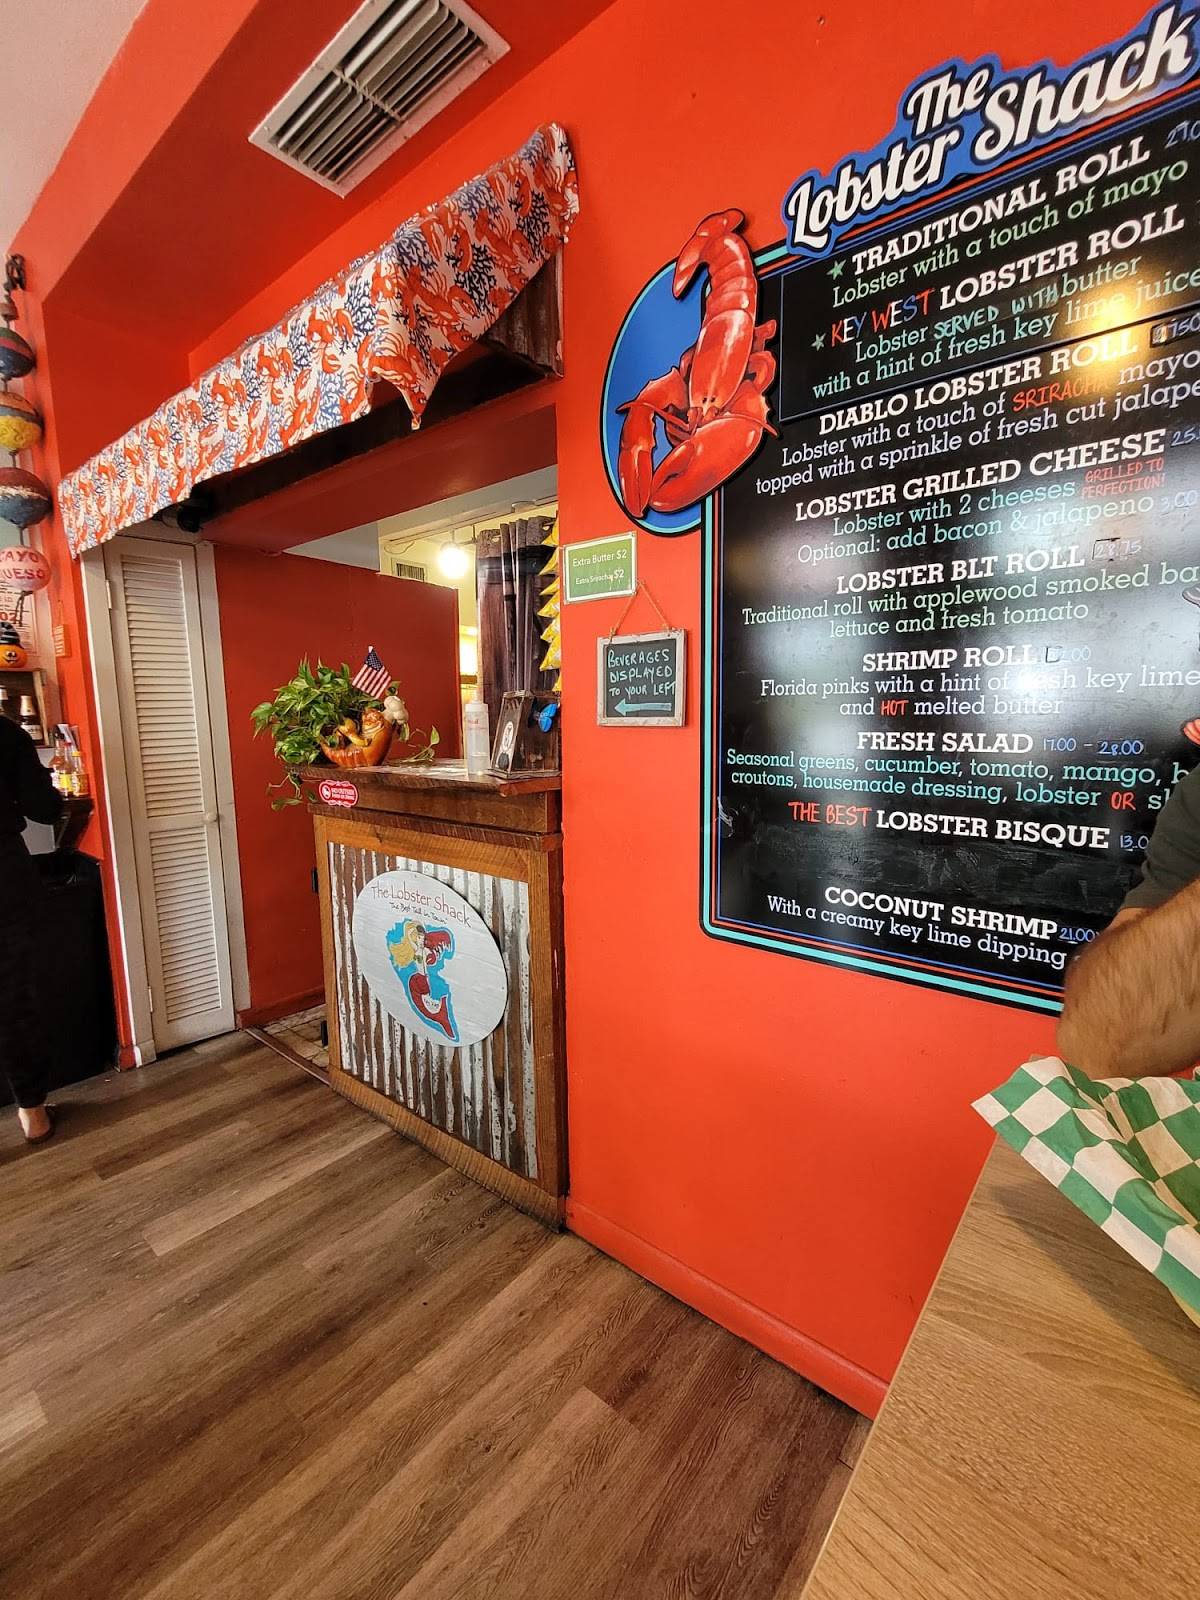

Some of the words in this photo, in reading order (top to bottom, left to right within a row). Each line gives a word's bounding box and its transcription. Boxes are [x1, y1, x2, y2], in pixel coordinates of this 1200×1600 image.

[907, 67, 988, 135] The
[788, 129, 960, 248] Lobster
[975, 5, 1197, 160] Shack
[852, 179, 1047, 276] TRADITIONAL
[1055, 136, 1150, 197] ROLL
[832, 267, 908, 308] Lobster
[913, 244, 959, 278] with
[966, 237, 983, 257] a
[989, 204, 1060, 250] touch
[1067, 187, 1095, 219] of
[1102, 160, 1189, 208] mayo
[831, 312, 867, 347] KEY
[872, 288, 935, 333] WEST
[939, 241, 1079, 311] LOBSTER
[1087, 203, 1185, 260] ROLL
[812, 371, 851, 399] with
[856, 371, 870, 386] a
[875, 352, 915, 381] hint
[920, 341, 943, 367] of
[947, 324, 1006, 361] fresh
[1013, 312, 1060, 342] key
[1064, 292, 1127, 325] lime
[1134, 264, 1200, 311] juice
[855, 326, 929, 363] Lobster
[933, 305, 1000, 340] SERVED
[1011, 282, 1060, 315] WITH
[1061, 256, 1143, 298] butter
[818, 393, 909, 435] DIABLO
[914, 356, 1042, 411] LOBSTER
[1050, 330, 1138, 376] ROLL
[782, 438, 847, 467] Lobster
[851, 422, 891, 449] with
[897, 422, 911, 438] a
[917, 402, 976, 434] touch
[983, 391, 1006, 417] of
[1118, 350, 1200, 386] mayo
[756, 464, 813, 495] topped
[818, 455, 855, 480] with
[861, 455, 874, 470] a
[879, 431, 962, 470] sprinkle
[968, 421, 991, 446] of
[996, 408, 1058, 441] fresh
[1066, 400, 1106, 425] cut
[1085, 461, 1143, 483] GRILLED
[1145, 458, 1164, 474] TO
[795, 484, 896, 522] LOBSTER
[902, 459, 1022, 501] GRILLED
[1029, 428, 1166, 476] CHEESE
[1081, 473, 1166, 499] PERFECTION!
[798, 534, 881, 566] Optional:
[886, 526, 927, 550] add
[933, 519, 1002, 544] bacon
[1010, 510, 1027, 531] &
[1033, 496, 1154, 536] jalapeno
[833, 511, 903, 536] Lobster
[908, 498, 952, 523] with
[958, 494, 971, 515] 2
[978, 482, 1076, 511] cheeses
[0, 567, 45, 579] UESO
[573, 558, 591, 567] Extra
[592, 553, 614, 564] Butter
[836, 563, 944, 595] LOBSTER
[951, 556, 998, 580] BLT
[1005, 545, 1085, 576] ROLL
[742, 600, 829, 625] Traditional
[833, 596, 863, 616] roll
[868, 592, 908, 613] with
[913, 576, 1037, 613] applewood
[1046, 564, 1149, 596] smoked
[830, 620, 890, 638] lettuce
[895, 610, 935, 633] and
[941, 606, 996, 629] fresh
[1003, 601, 1089, 625] tomato
[607, 649, 670, 668] BEVERAGES
[610, 665, 673, 684] DISPLAYED
[761, 679, 817, 697] Florida
[823, 677, 870, 698] pinks
[875, 674, 914, 693] with
[920, 678, 934, 692] a
[940, 672, 981, 692] hint
[988, 671, 1010, 691] of
[1085, 667, 1132, 693] key
[1139, 665, 1200, 687] lime
[863, 649, 957, 672] SHRIMP
[963, 644, 1037, 668] ROLL
[609, 687, 621, 697] TO
[625, 684, 648, 699] YOUR
[653, 680, 677, 696] LEFT
[840, 698, 874, 716] and
[880, 700, 909, 716] HOT
[913, 695, 985, 716] melted
[993, 695, 1064, 714] butter
[727, 748, 794, 767] Seasonal
[799, 755, 859, 772] greens,
[865, 755, 962, 776] cucumber,
[971, 758, 1053, 781] tomato,
[1062, 764, 1161, 788] mango,
[857, 732, 935, 751] FRESH
[942, 732, 1033, 753] SALAD
[1098, 740, 1144, 756] 28.00
[731, 770, 797, 789] croutons,
[803, 773, 906, 794] housemade
[911, 777, 1007, 805] dressing,
[1015, 782, 1101, 806] lobster
[1111, 791, 1136, 810] OR
[788, 801, 820, 823] THE
[826, 804, 872, 827] BEST
[876, 810, 988, 838] LOBSTER
[995, 820, 1110, 848] BISQUE
[371, 880, 389, 899] The
[391, 881, 431, 906] Lobster
[434, 893, 471, 928] Shack
[825, 886, 944, 921] COCONUT
[951, 905, 1058, 940] SHRIMP
[768, 895, 802, 917] With
[806, 906, 816, 919] a
[821, 909, 885, 936] creamy
[889, 917, 923, 943] key
[927, 924, 972, 948] lime
[977, 933, 1067, 970] dipping
